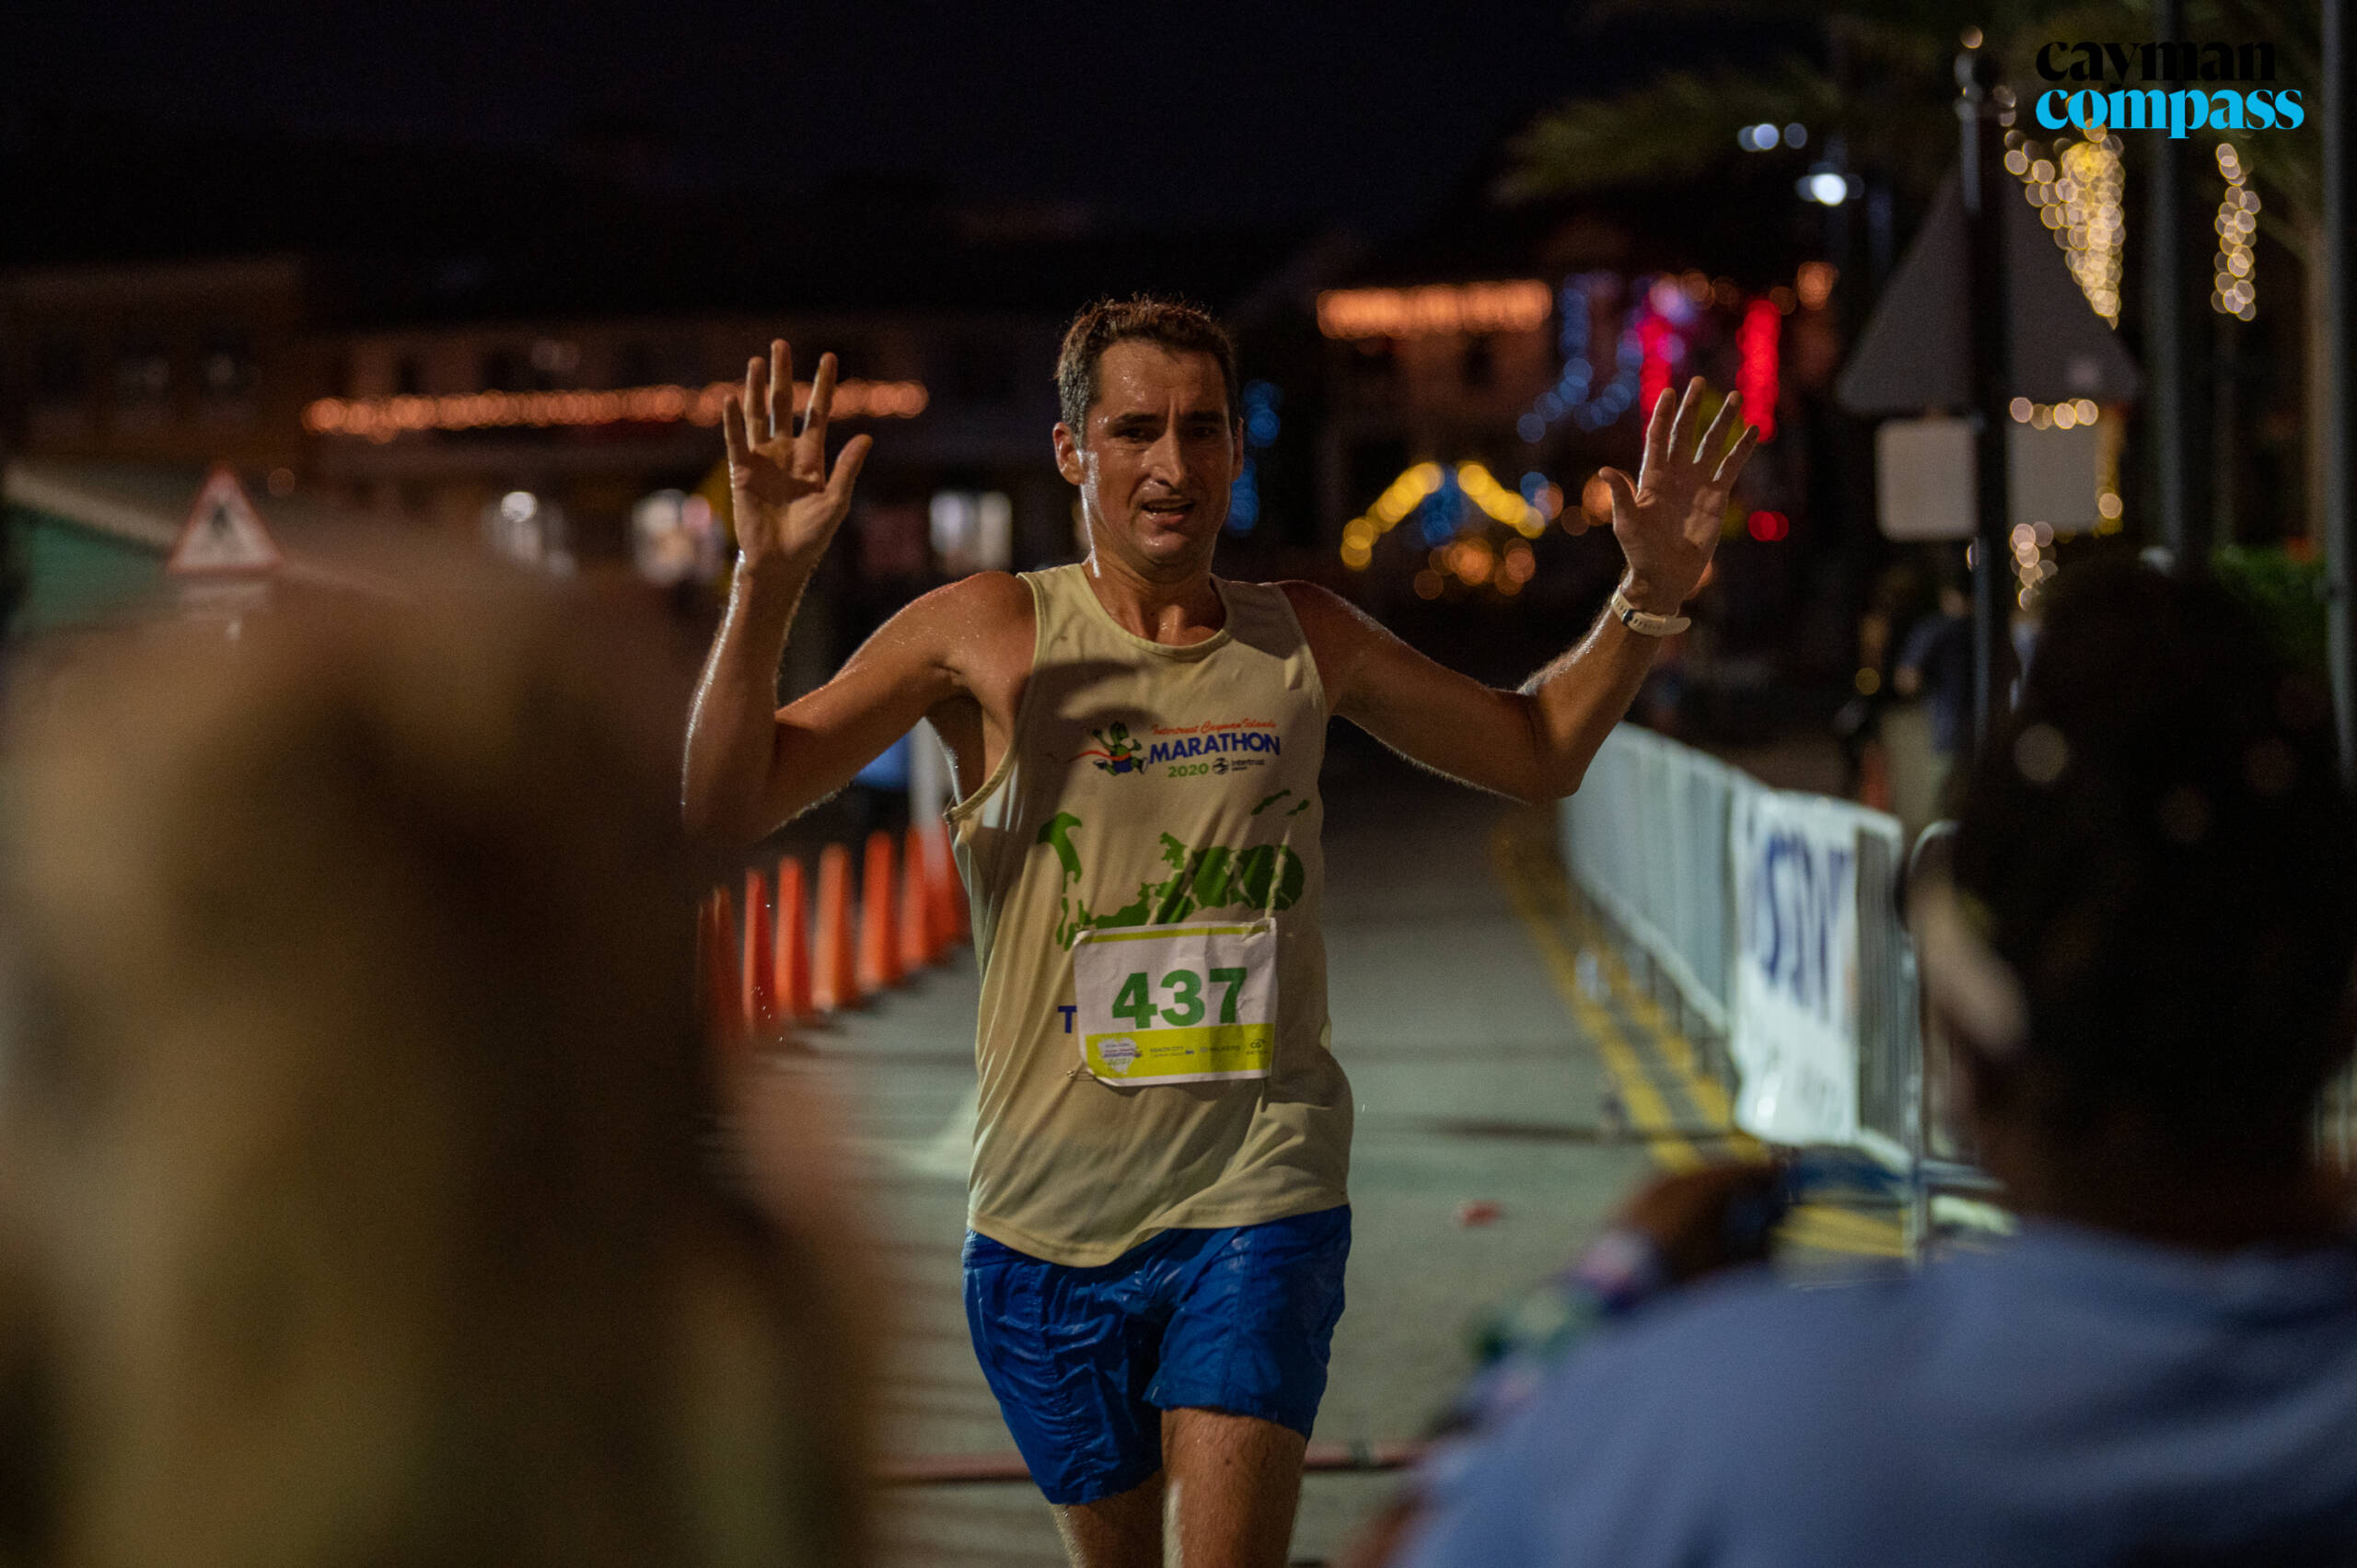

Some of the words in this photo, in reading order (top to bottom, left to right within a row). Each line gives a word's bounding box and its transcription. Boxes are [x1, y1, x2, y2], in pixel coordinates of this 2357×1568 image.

[1201, 720, 1241, 735] Cayman
[1242, 717, 1276, 727] Islands
[1149, 732, 1281, 764] MARATHON
[1168, 762, 1209, 777] 2020
[1111, 967, 1247, 1028] 437
